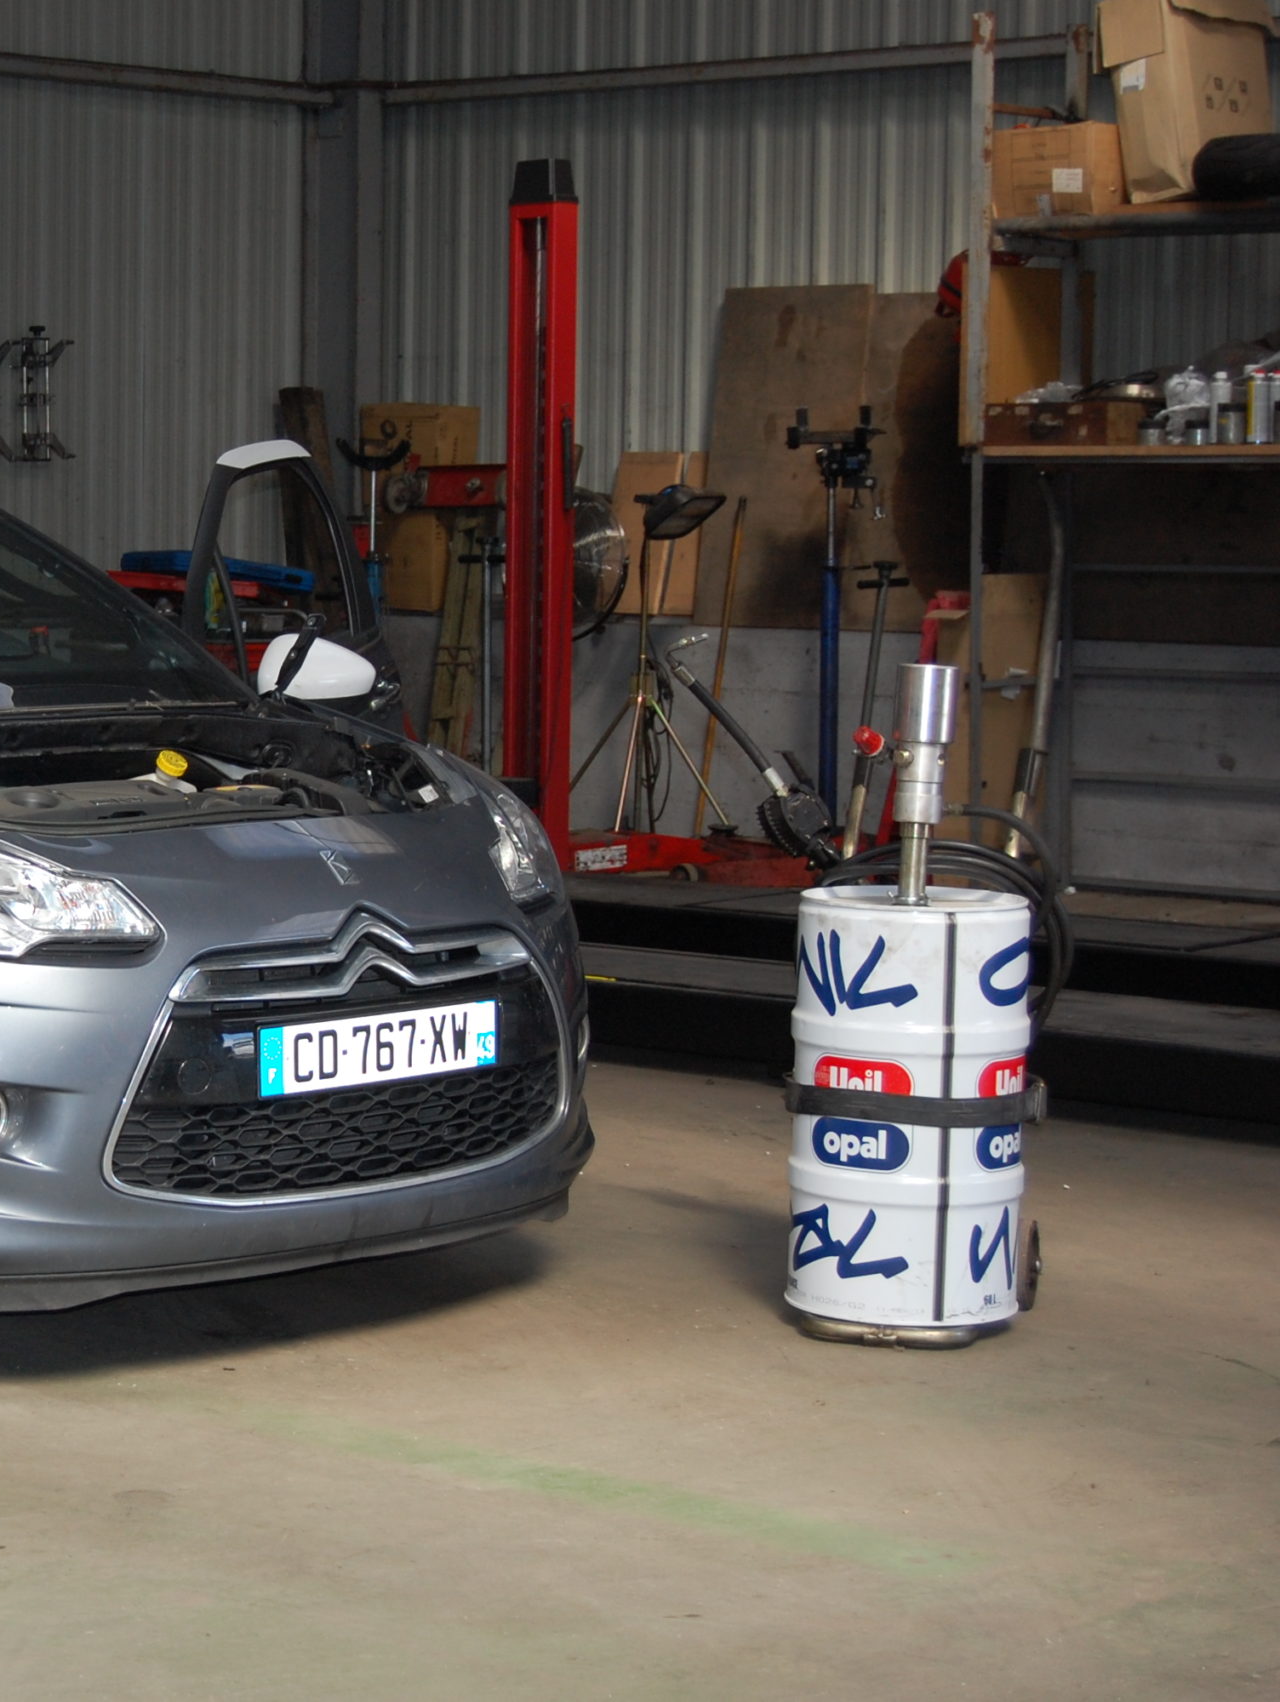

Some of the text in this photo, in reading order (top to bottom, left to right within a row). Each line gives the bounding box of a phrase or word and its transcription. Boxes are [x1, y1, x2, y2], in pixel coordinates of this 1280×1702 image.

[797, 929, 918, 1016] NIL
[268, 1067, 277, 1084] F
[823, 1130, 887, 1162] opal
[989, 1131, 1021, 1163] opa
